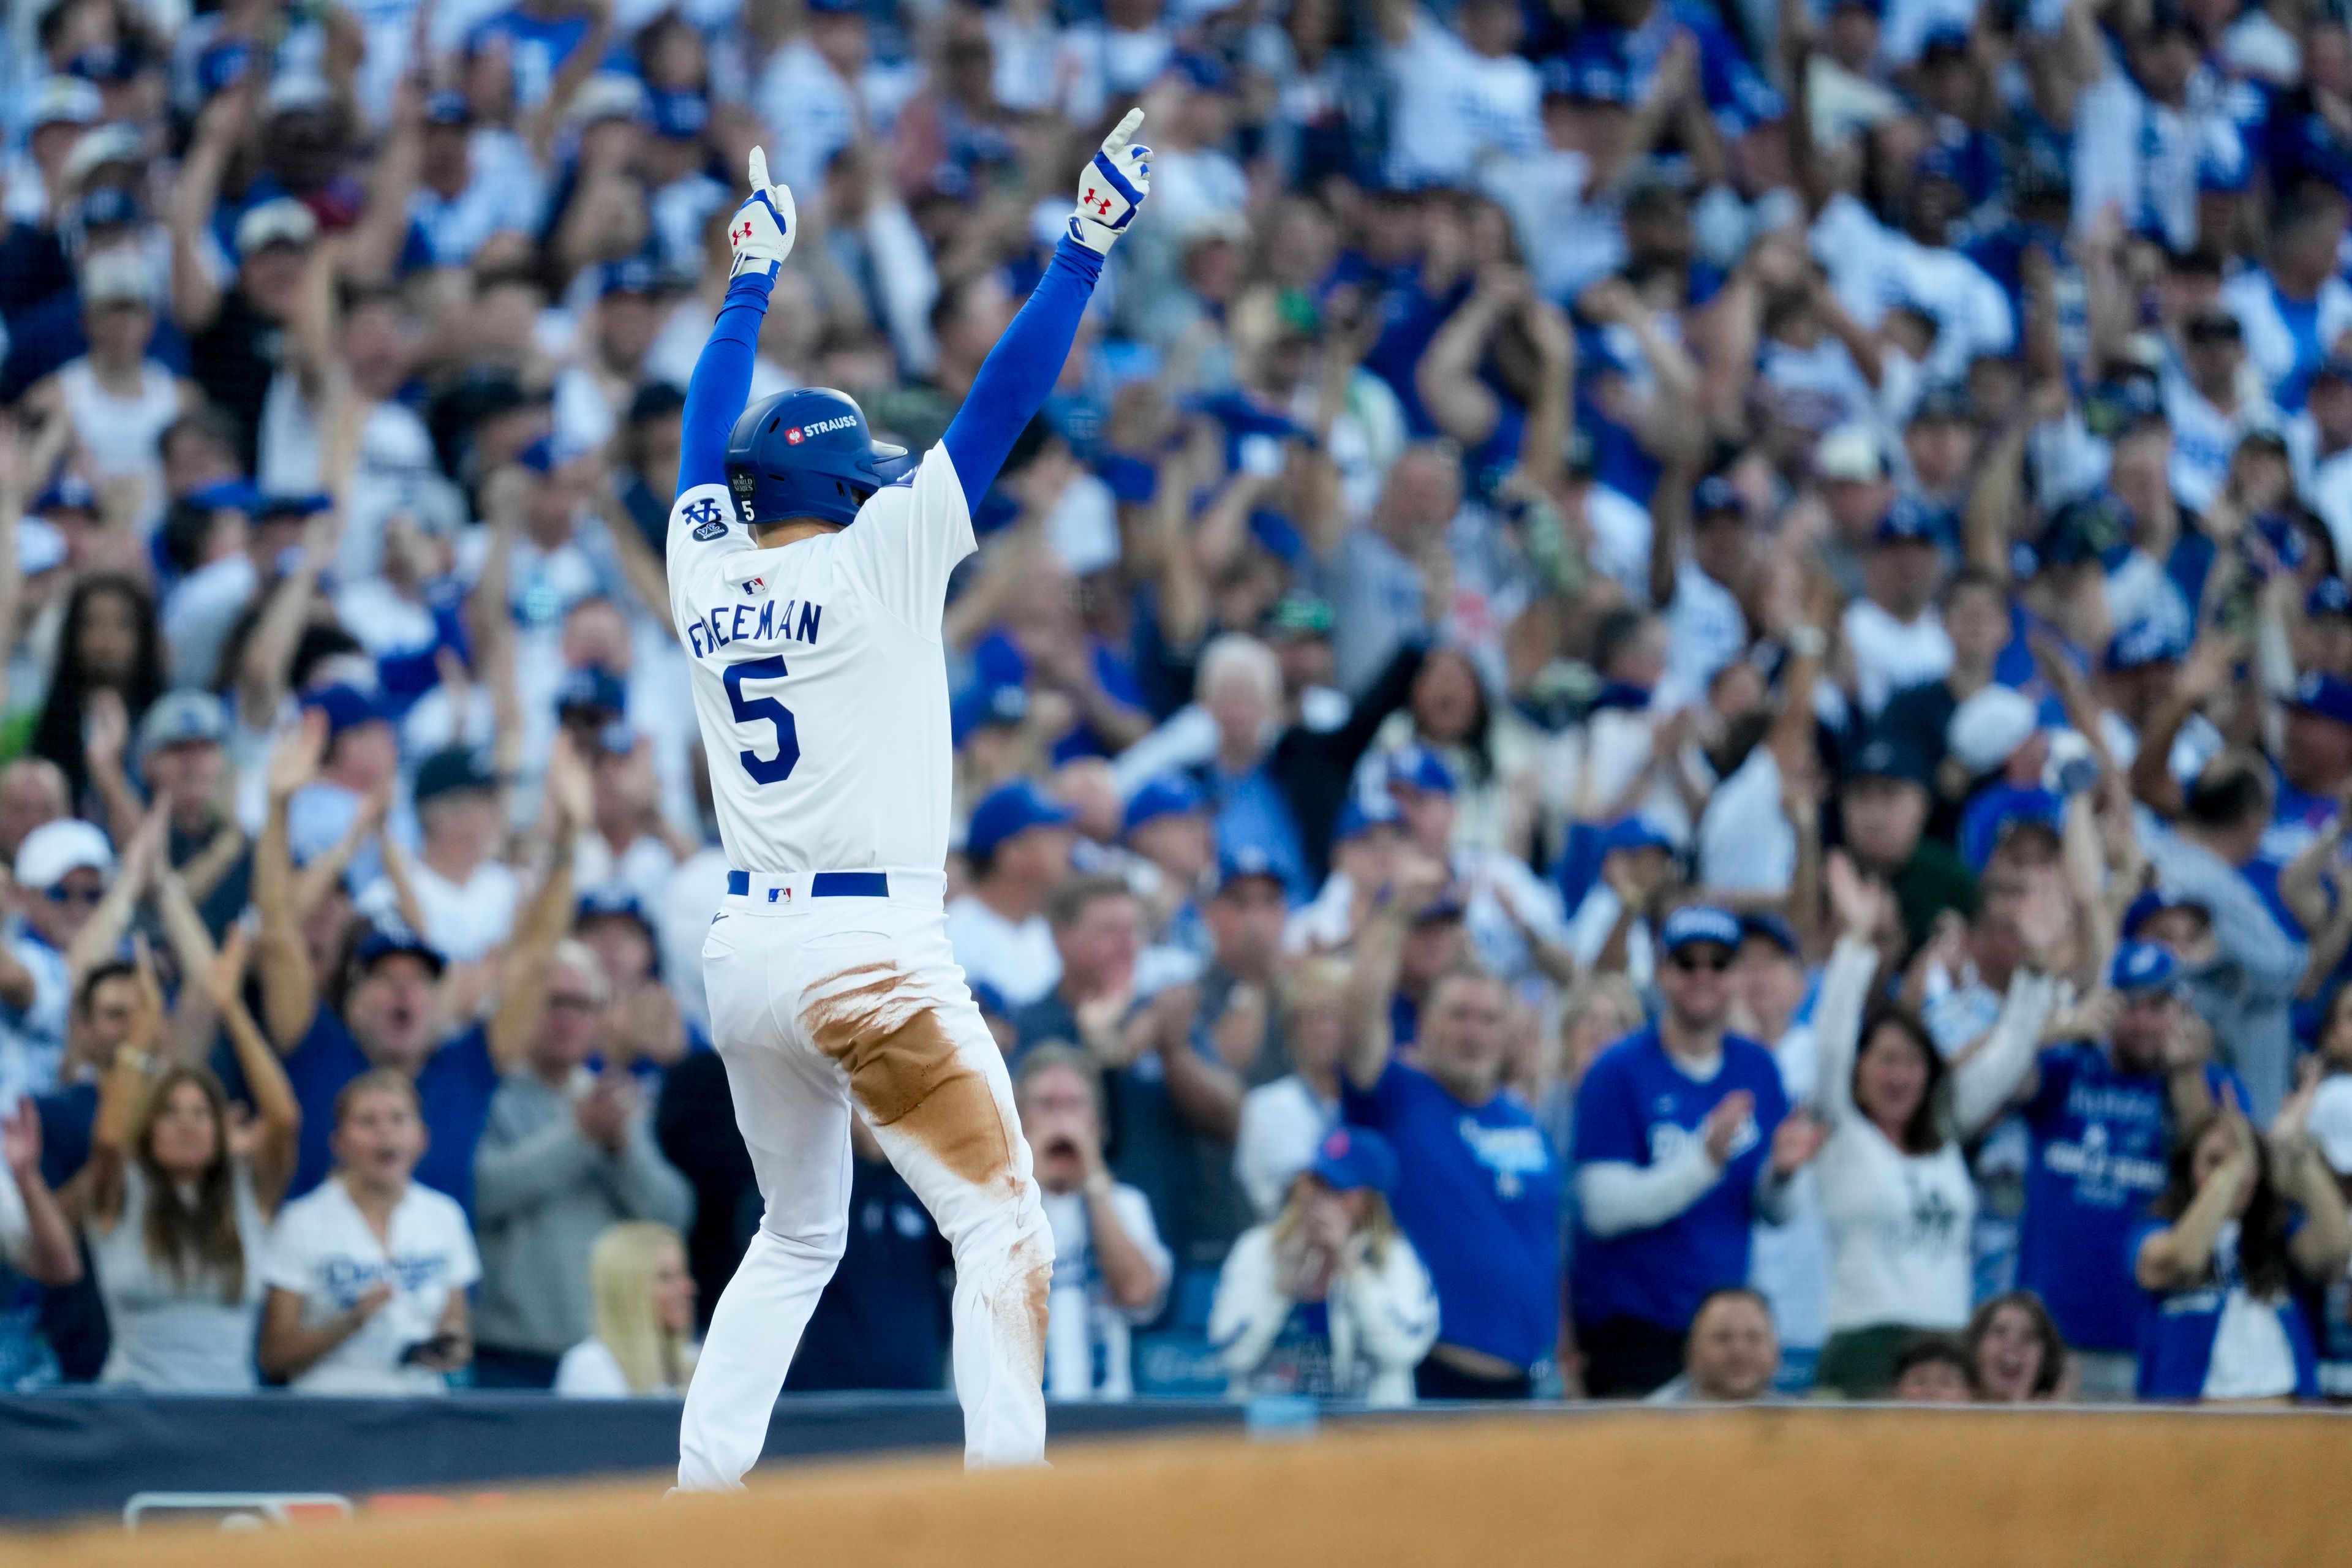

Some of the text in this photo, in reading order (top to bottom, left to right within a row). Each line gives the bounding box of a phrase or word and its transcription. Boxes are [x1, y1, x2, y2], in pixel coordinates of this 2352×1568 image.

[804, 415, 857, 437] STRAUSS
[741, 500, 755, 521] 5
[696, 522, 720, 536] 34
[688, 600, 822, 658] FREEMAN
[723, 654, 801, 785] 5
